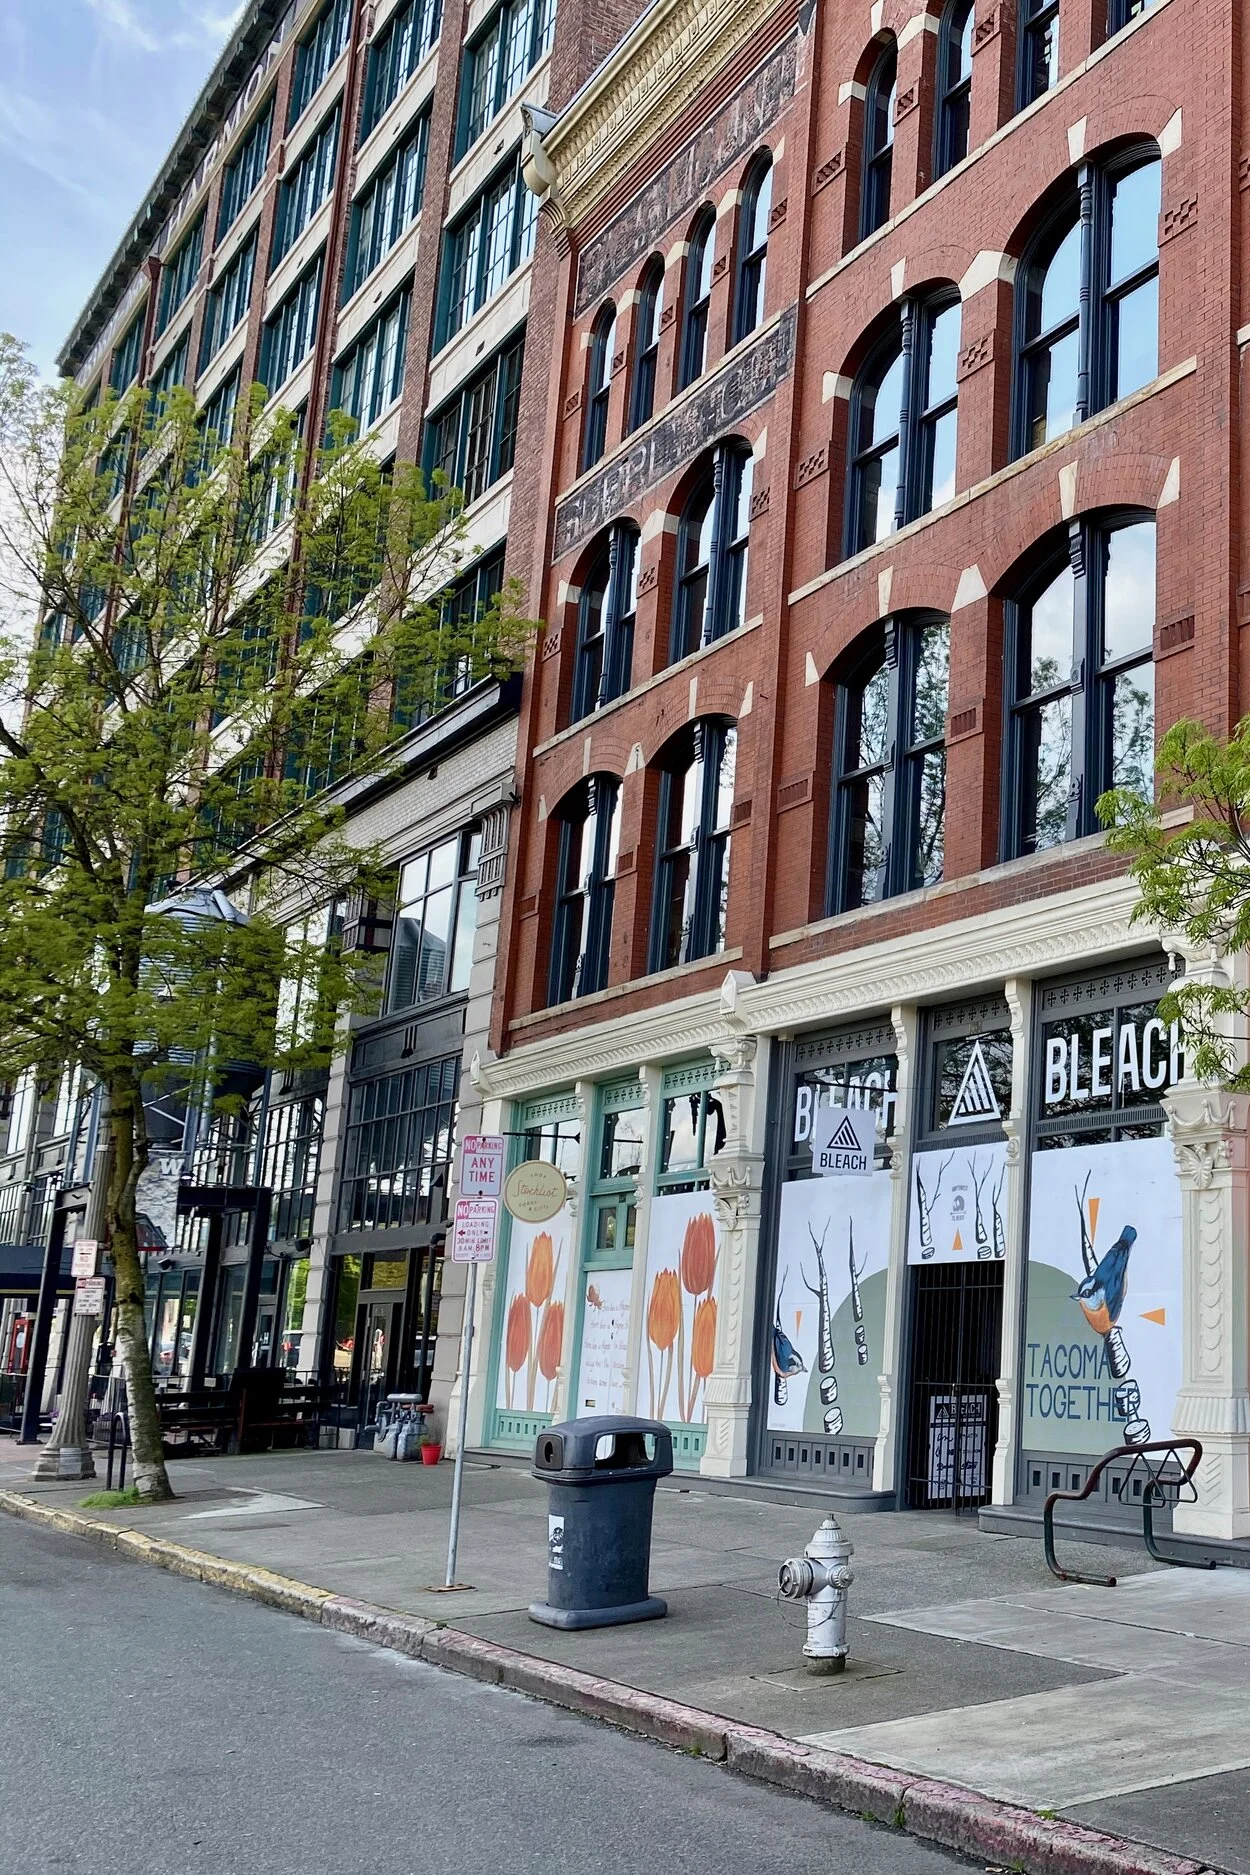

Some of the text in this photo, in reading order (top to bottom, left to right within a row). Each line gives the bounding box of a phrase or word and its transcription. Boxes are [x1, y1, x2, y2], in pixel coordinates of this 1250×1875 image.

[465, 1139, 502, 1151] NO PARKING
[158, 1158, 185, 1175] W
[471, 1157, 495, 1169] ANY
[819, 1152, 867, 1171] BLEACH
[469, 1170, 495, 1183] TIME
[457, 1204, 496, 1217] NO PARKING
[1027, 1343, 1112, 1380] TACOMA
[950, 1404, 981, 1415] BEACH
[1026, 1383, 1141, 1423] TOGETHER
